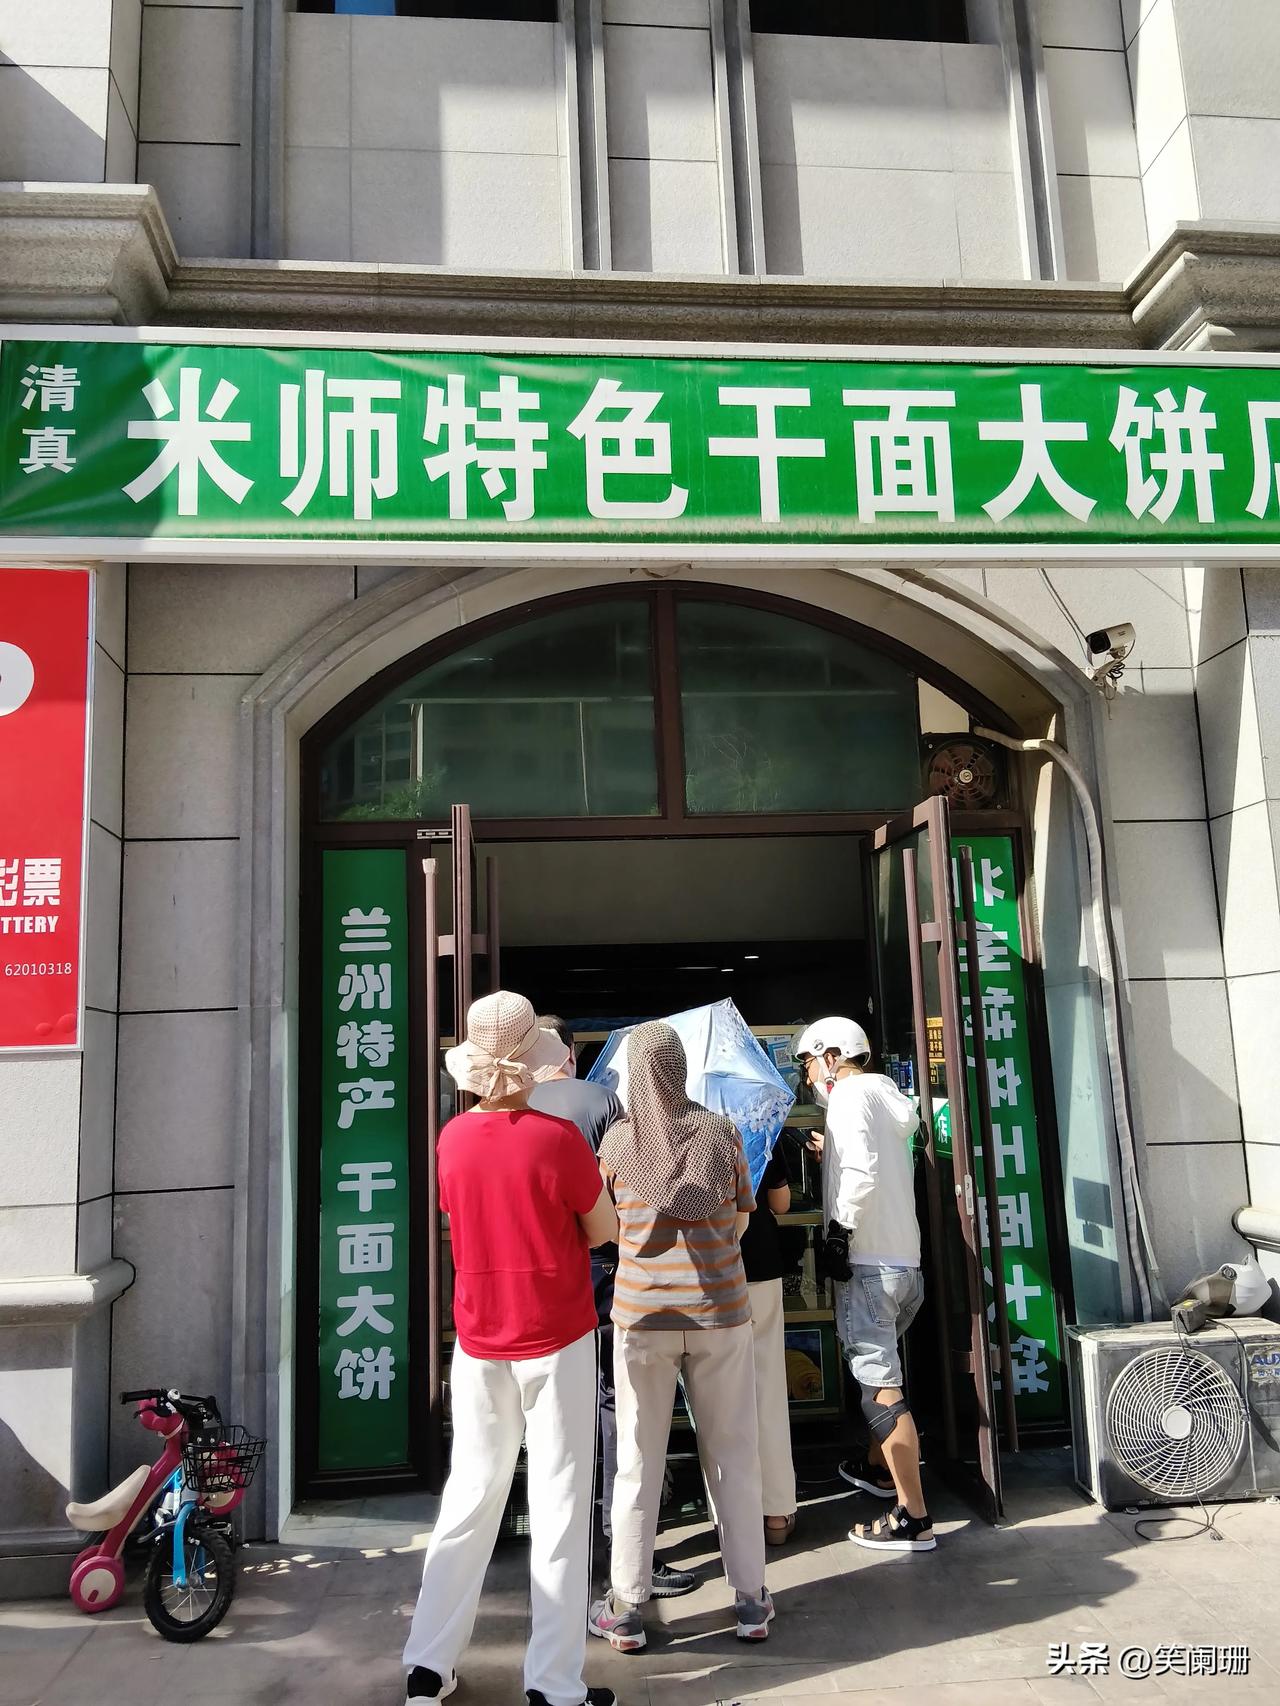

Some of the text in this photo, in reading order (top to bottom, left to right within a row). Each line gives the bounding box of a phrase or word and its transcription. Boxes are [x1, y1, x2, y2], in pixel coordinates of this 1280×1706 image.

[19, 363, 82, 476] 清真
[121, 366, 1280, 524] 米师特色干面大饼
[4, 962, 72, 976] 62010318
[336, 906, 397, 1402] 兰州特产 干面大饼
